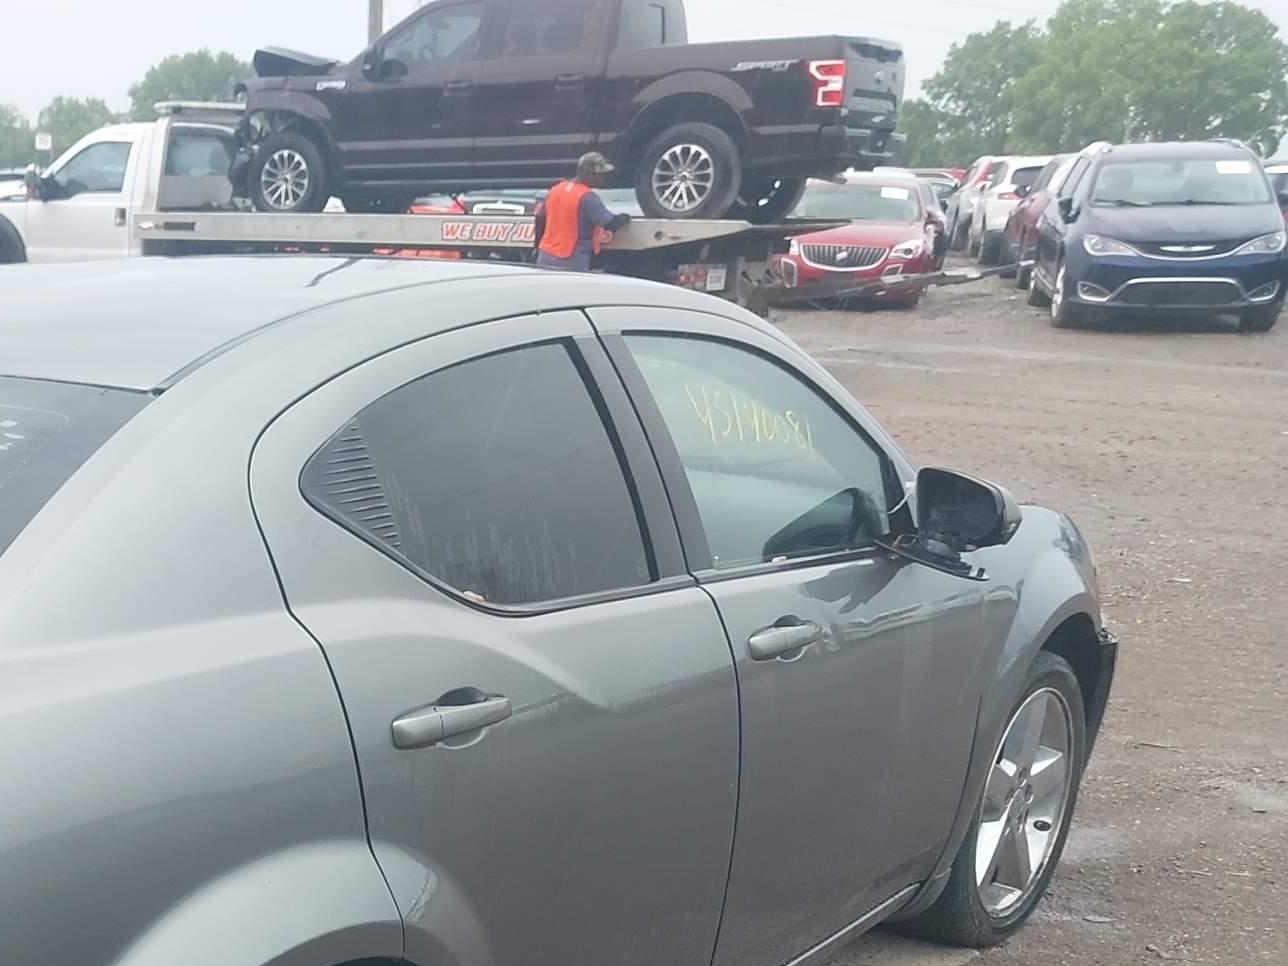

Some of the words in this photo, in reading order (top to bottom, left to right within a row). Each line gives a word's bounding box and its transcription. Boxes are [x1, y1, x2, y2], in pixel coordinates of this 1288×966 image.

[442, 222, 472, 240] WE
[472, 222, 513, 240] BUY
[511, 222, 535, 241] JU
[684, 383, 813, 455] 45140081
